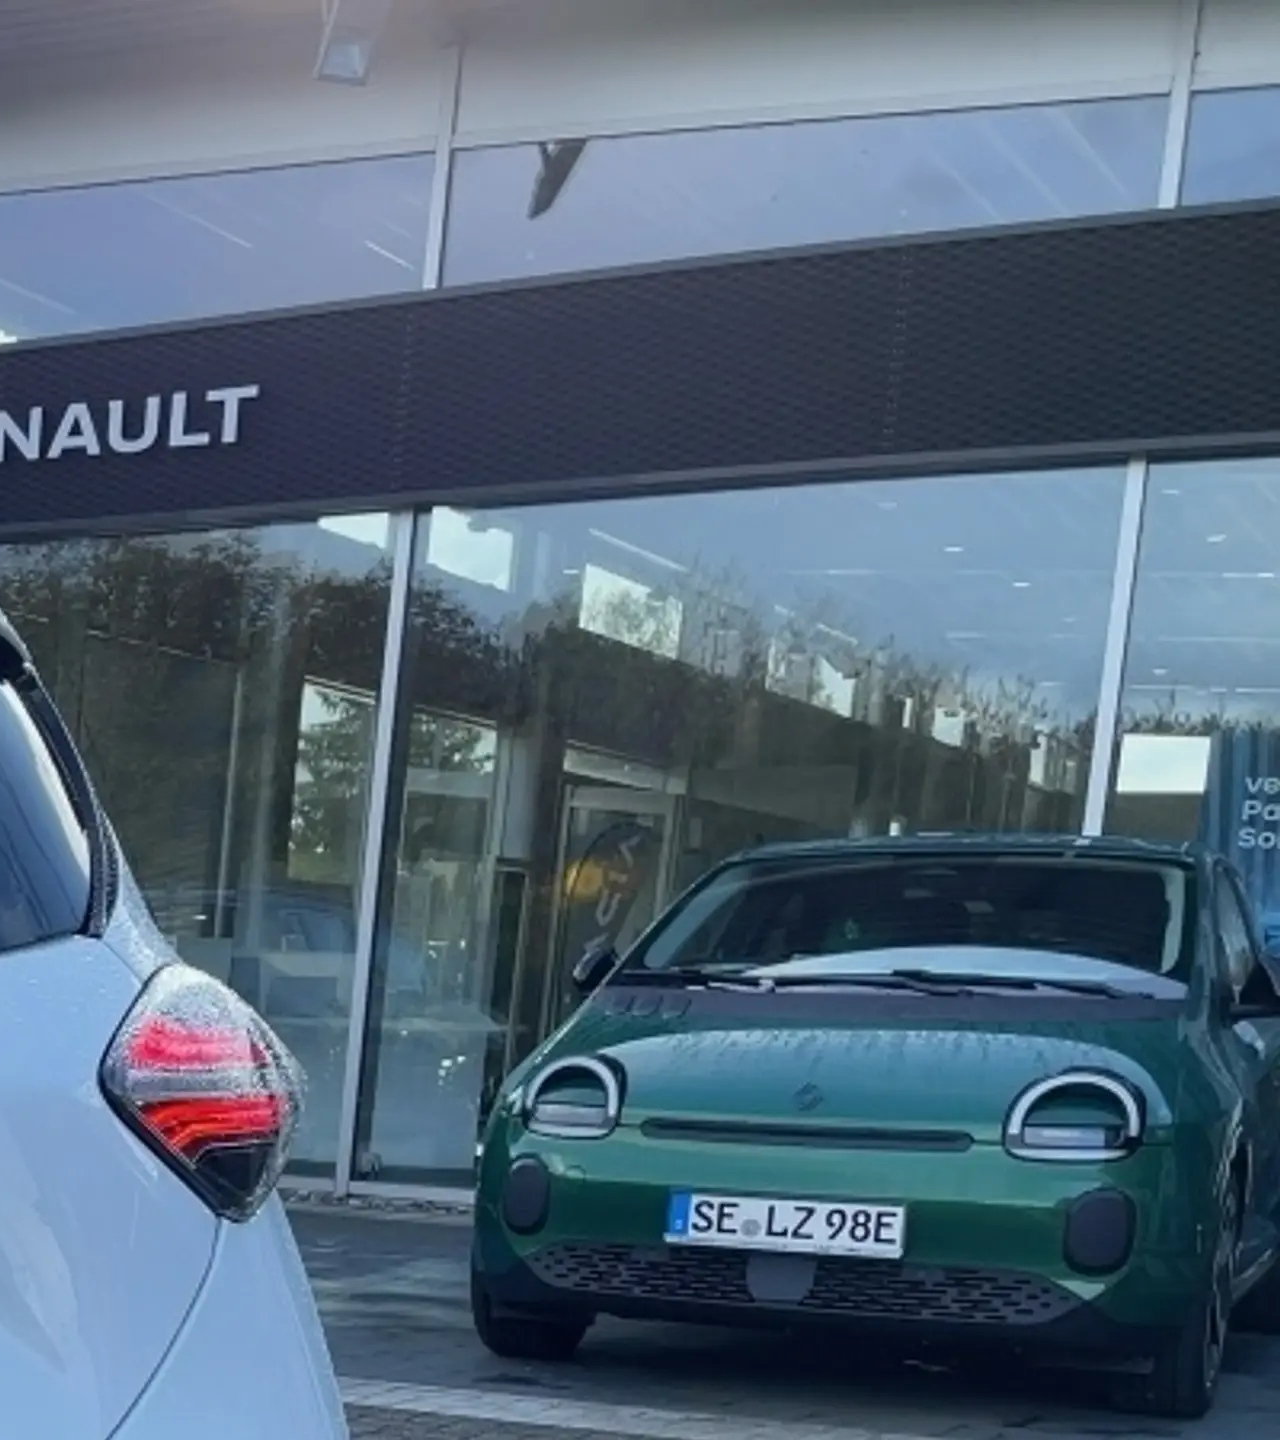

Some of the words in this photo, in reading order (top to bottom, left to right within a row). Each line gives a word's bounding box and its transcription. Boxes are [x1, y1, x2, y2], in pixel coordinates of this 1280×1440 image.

[1238, 827, 1280, 850] So
[691, 1200, 740, 1235] SE
[764, 1204, 817, 1240] LZ
[825, 1208, 899, 1245] 98E
